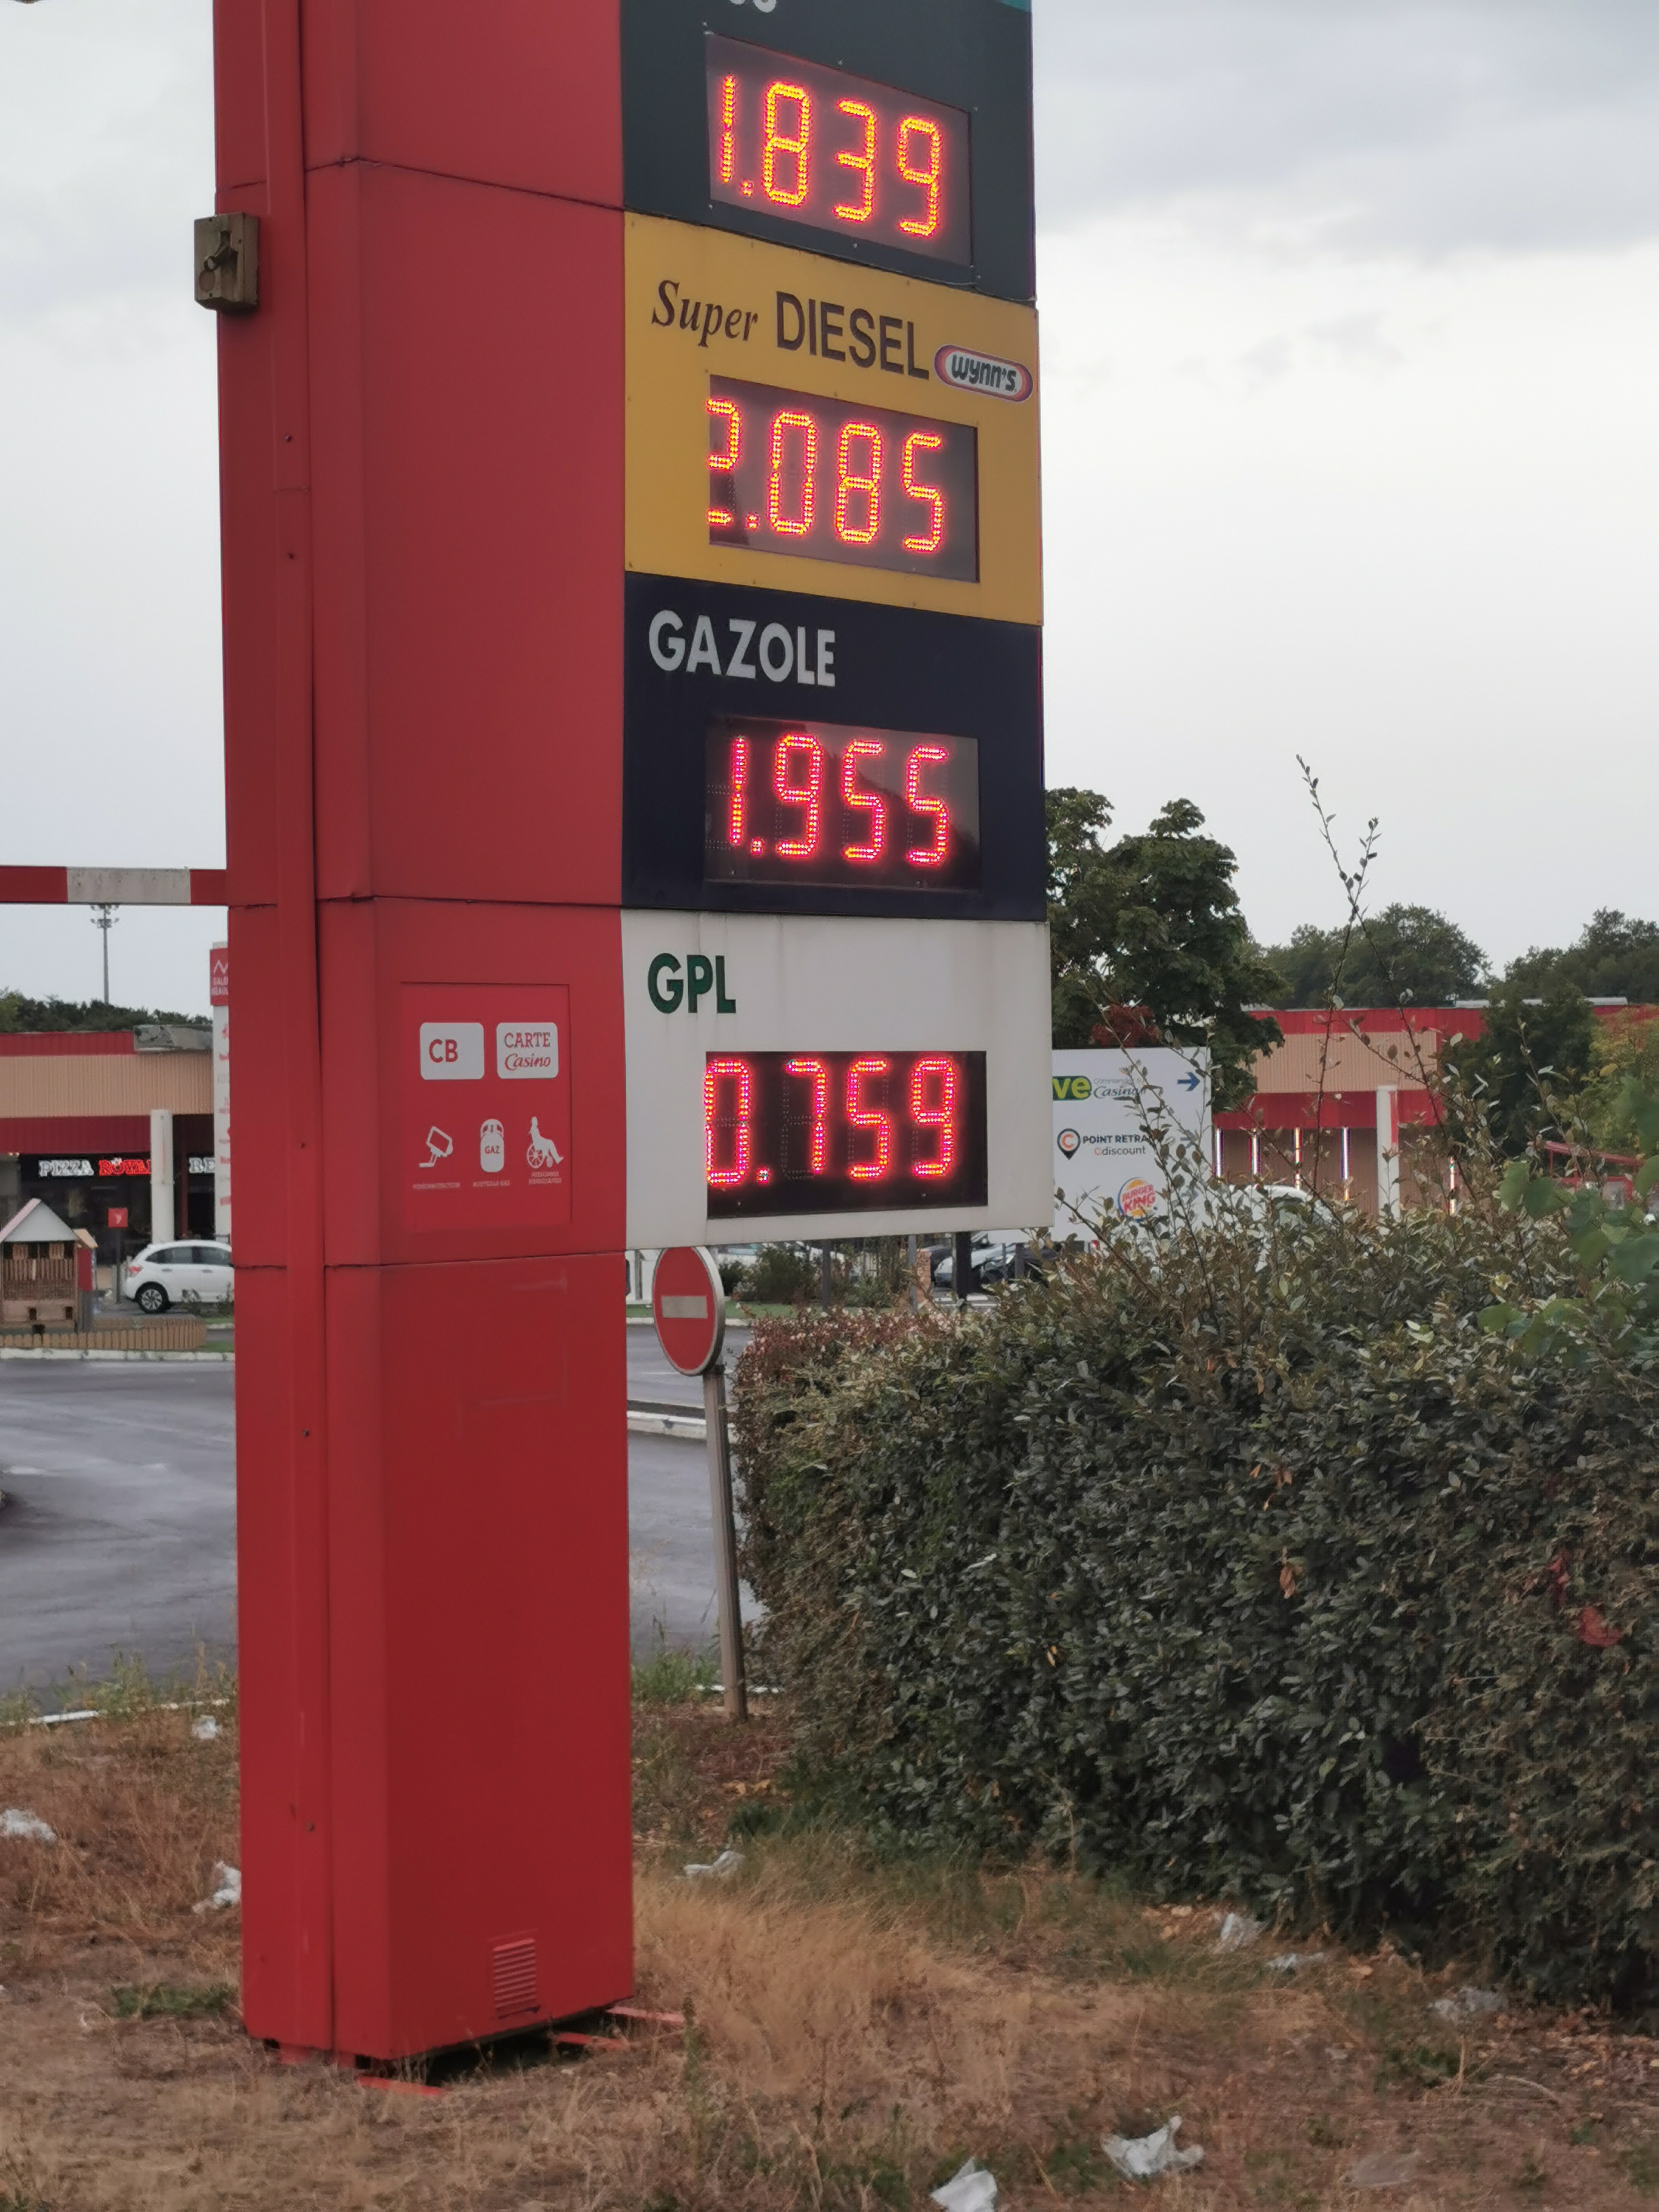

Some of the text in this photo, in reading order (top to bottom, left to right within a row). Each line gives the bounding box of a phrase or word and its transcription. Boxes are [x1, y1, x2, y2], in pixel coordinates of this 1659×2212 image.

[719, 74, 943, 238] 1.839
[651, 280, 930, 380] Super DIESEL
[706, 397, 943, 553] 2.085
[649, 609, 836, 687] GAZOLE
[728, 734, 950, 866] 1.955
[647, 953, 736, 1014] GPL
[429, 1039, 458, 1063] CB
[504, 1032, 551, 1048] CARTE
[504, 1053, 551, 1071] Casino
[705, 1059, 957, 1186] 0.759
[484, 1145, 500, 1155] GAZ
[1083, 1134, 1151, 1144] POINT RETRA
[1094, 1145, 1146, 1156] Cdiscount
[38, 1159, 94, 1176] PIZZA
[1122, 1184, 1154, 1202] BURGER
[1124, 1193, 1156, 1214] KING
